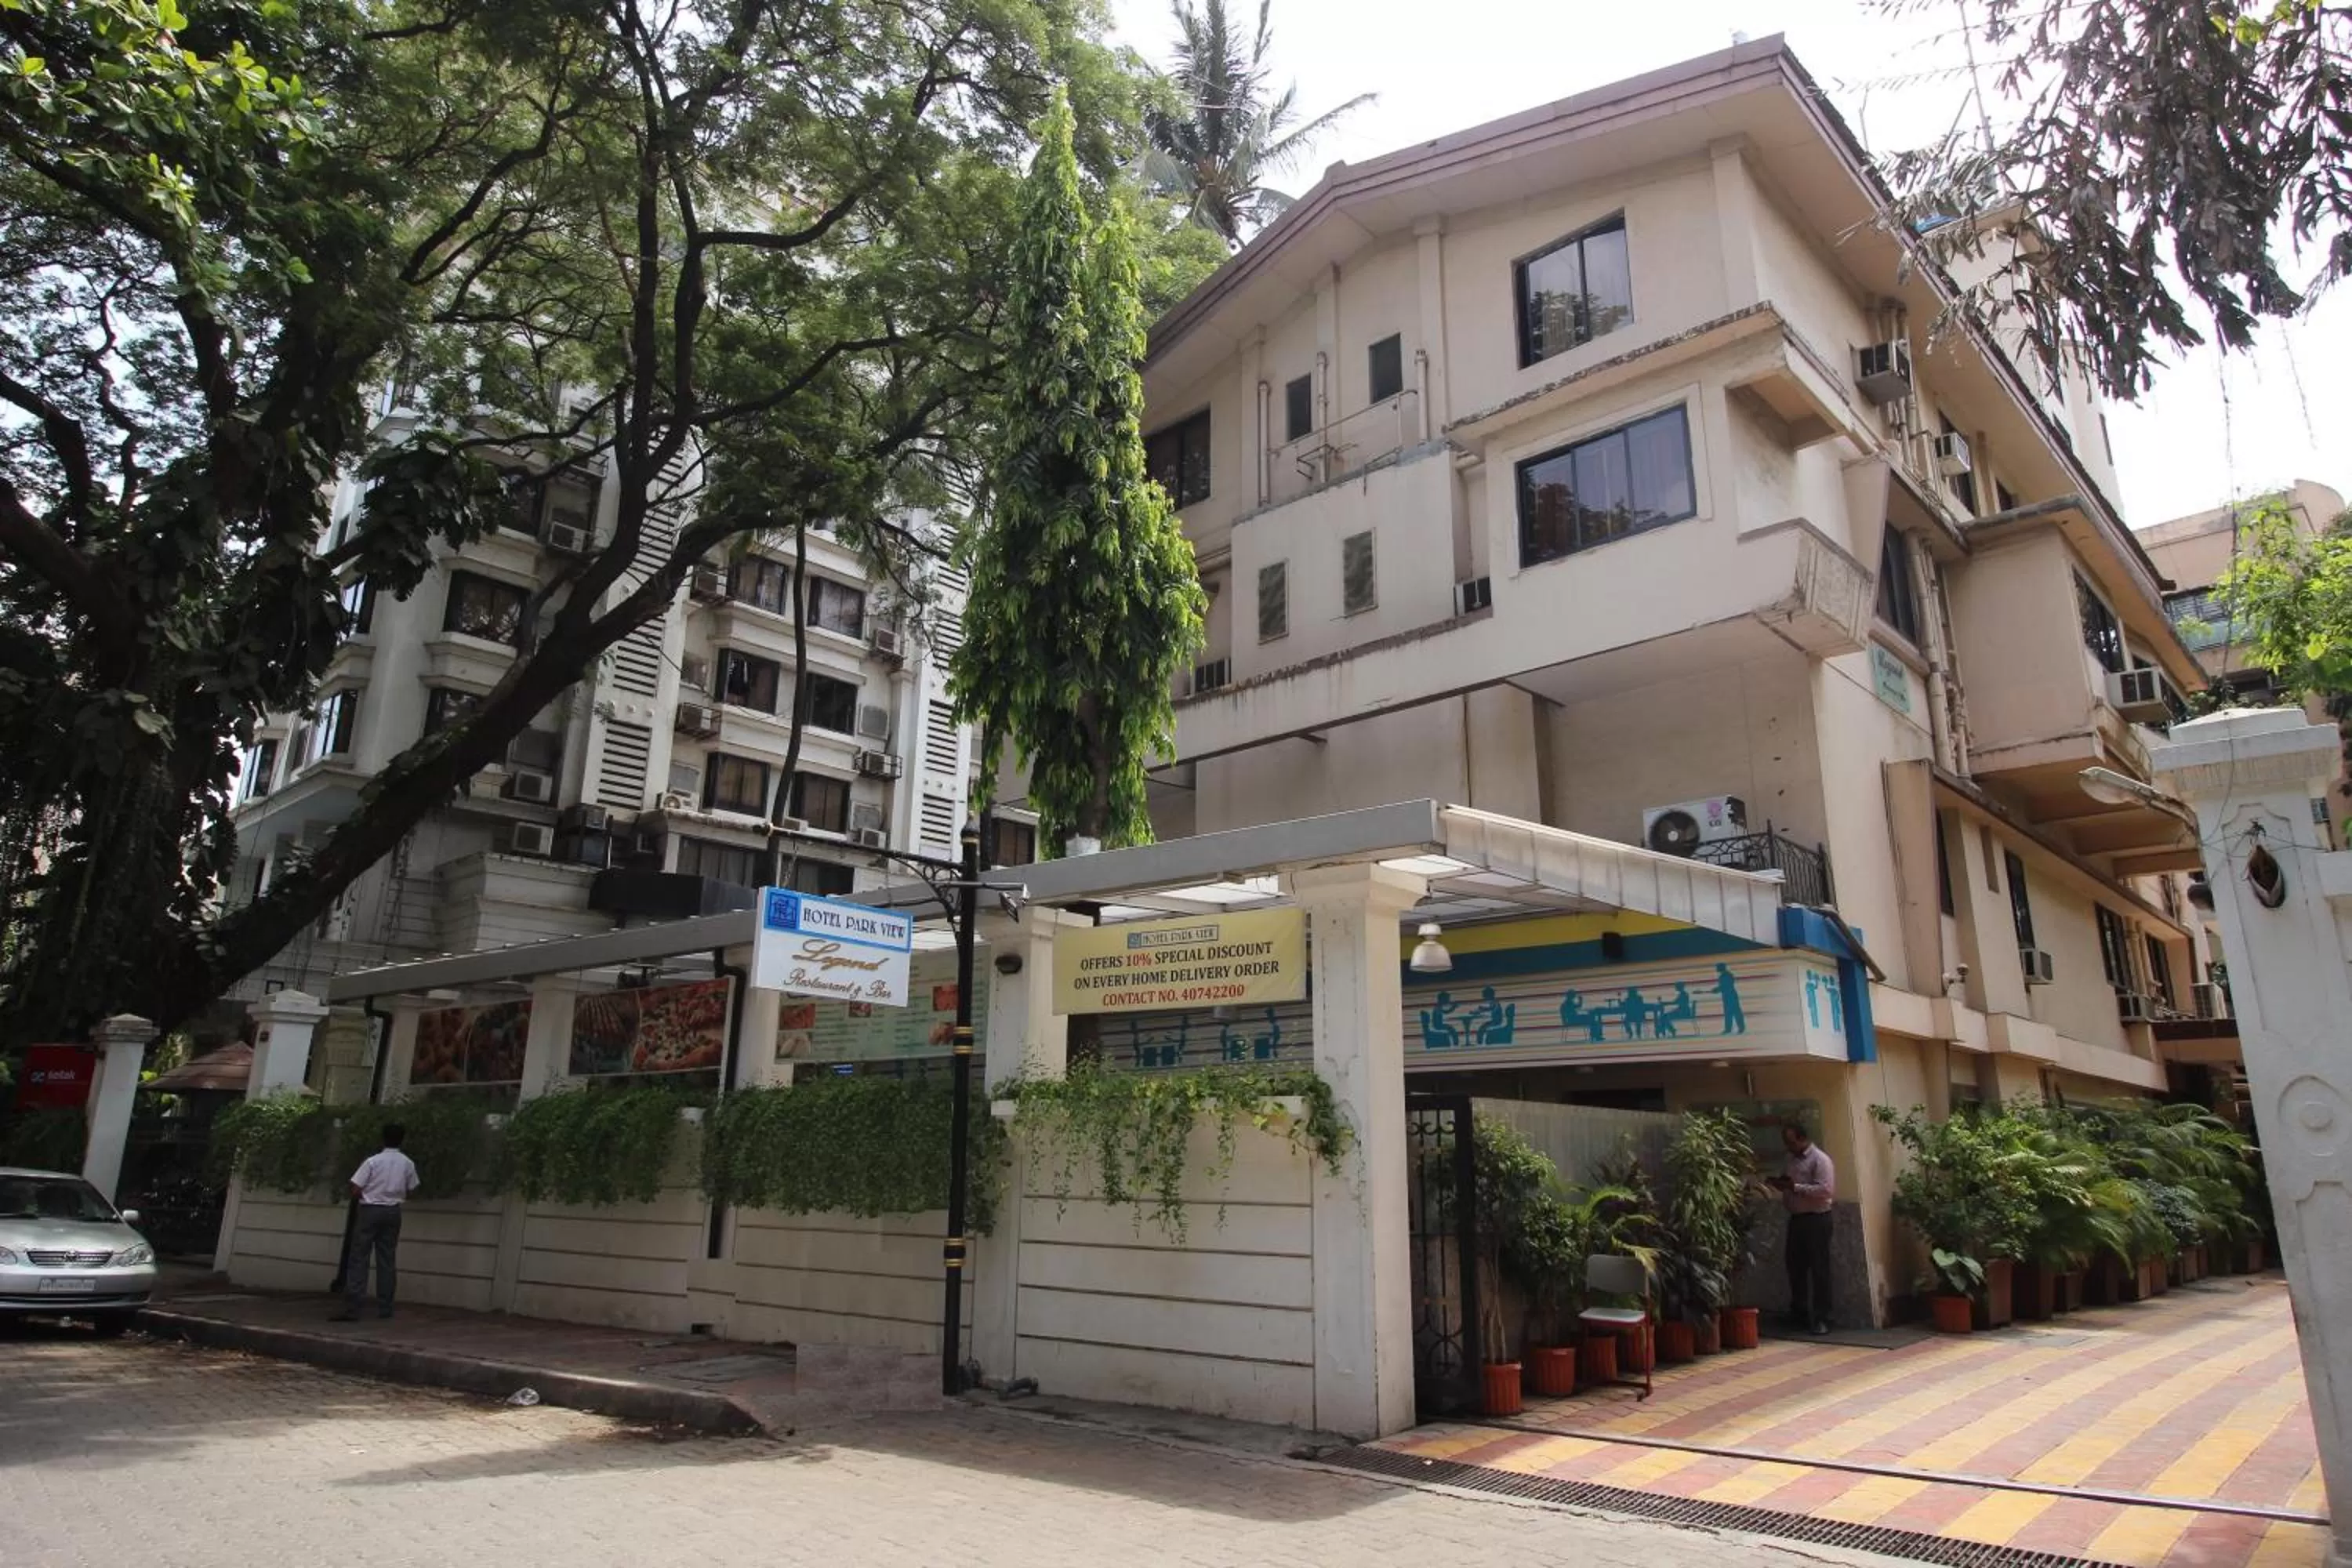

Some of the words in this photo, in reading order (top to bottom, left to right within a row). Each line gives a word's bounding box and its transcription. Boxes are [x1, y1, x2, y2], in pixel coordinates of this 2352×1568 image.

[803, 907, 841, 928] HOTEL
[845, 916, 877, 934] PARK
[880, 923, 906, 938] VIEW
[791, 938, 890, 971] Legend
[1080, 955, 1123, 971] OFFERS
[1126, 953, 1152, 967] 10%
[1155, 949, 1205, 964] SPECIAL
[1207, 941, 1274, 959] DISCOUNT
[783, 967, 852, 993] Restaurant
[866, 979, 892, 999] Bar
[1074, 976, 1091, 989] ON
[1093, 974, 1130, 988] EVERY
[1131, 970, 1167, 985] HOME
[1171, 965, 1231, 982] DELIVERY
[1234, 960, 1279, 978] ORDER
[1103, 990, 1156, 1006] CONTACT
[1158, 988, 1178, 1003] NO.
[1181, 984, 1245, 1001] 40742200
